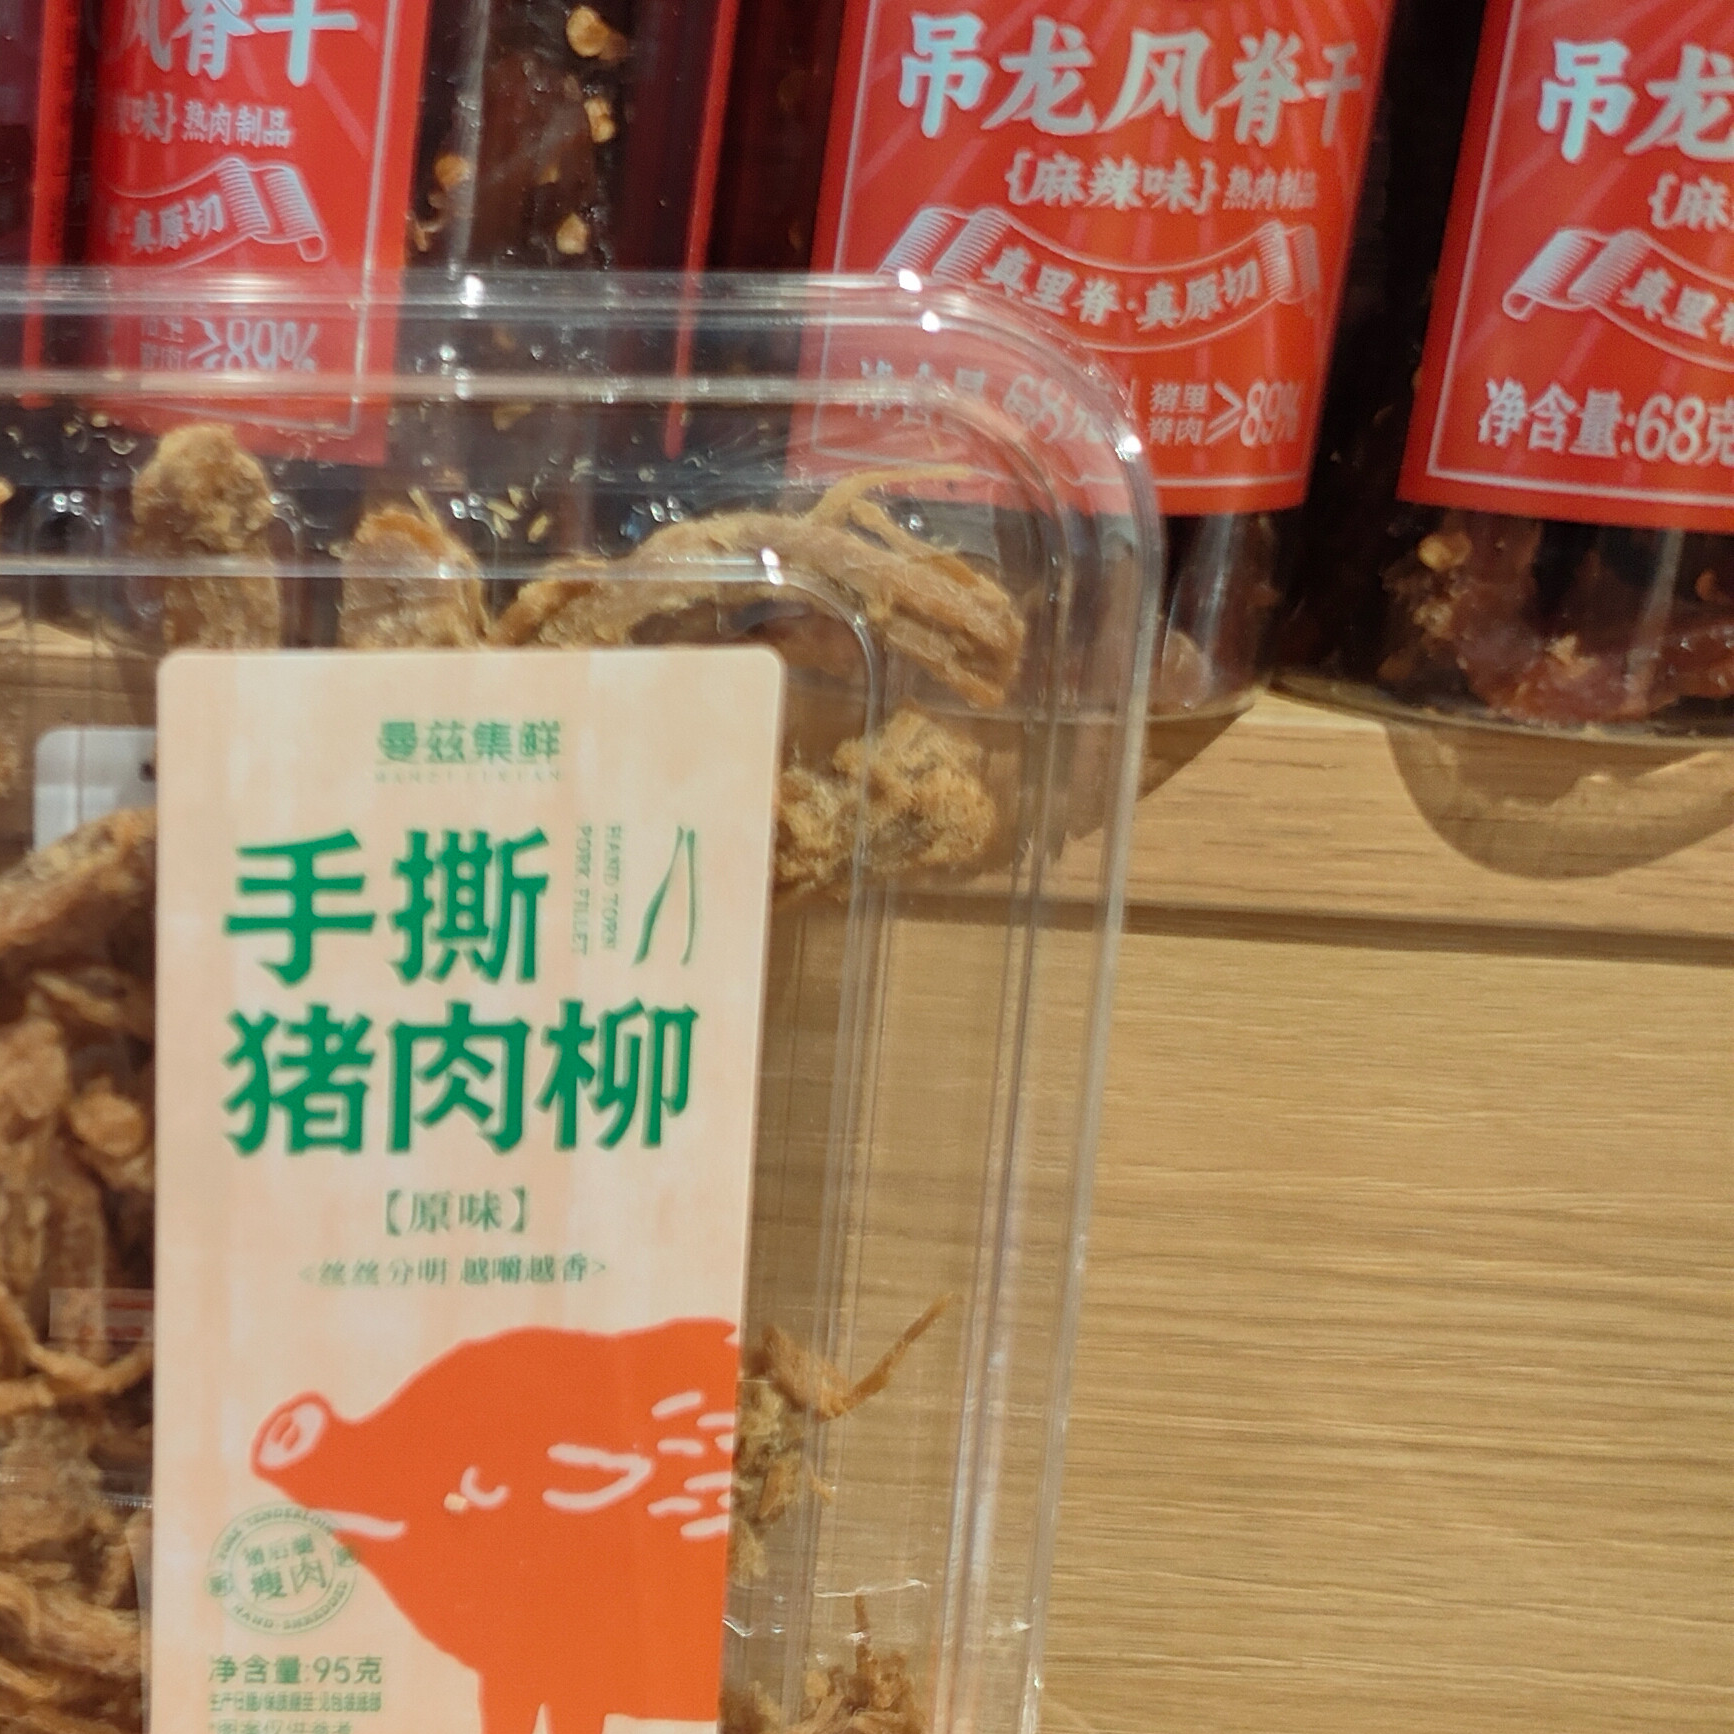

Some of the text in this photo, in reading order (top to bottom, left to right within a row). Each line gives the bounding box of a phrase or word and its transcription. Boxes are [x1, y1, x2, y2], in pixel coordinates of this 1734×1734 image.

[182, 100, 291, 148] 熟肉制品
[898, 10, 1362, 147] 吊龙风脊干
[1537, 37, 1734, 163] 吊龙
[1005, 147, 1219, 214] {麻辣味}
[223, 828, 551, 985] 手撕
[222, 998, 700, 1156] 猪肉柳
[209, 1654, 383, 1684] 净含量:95克
